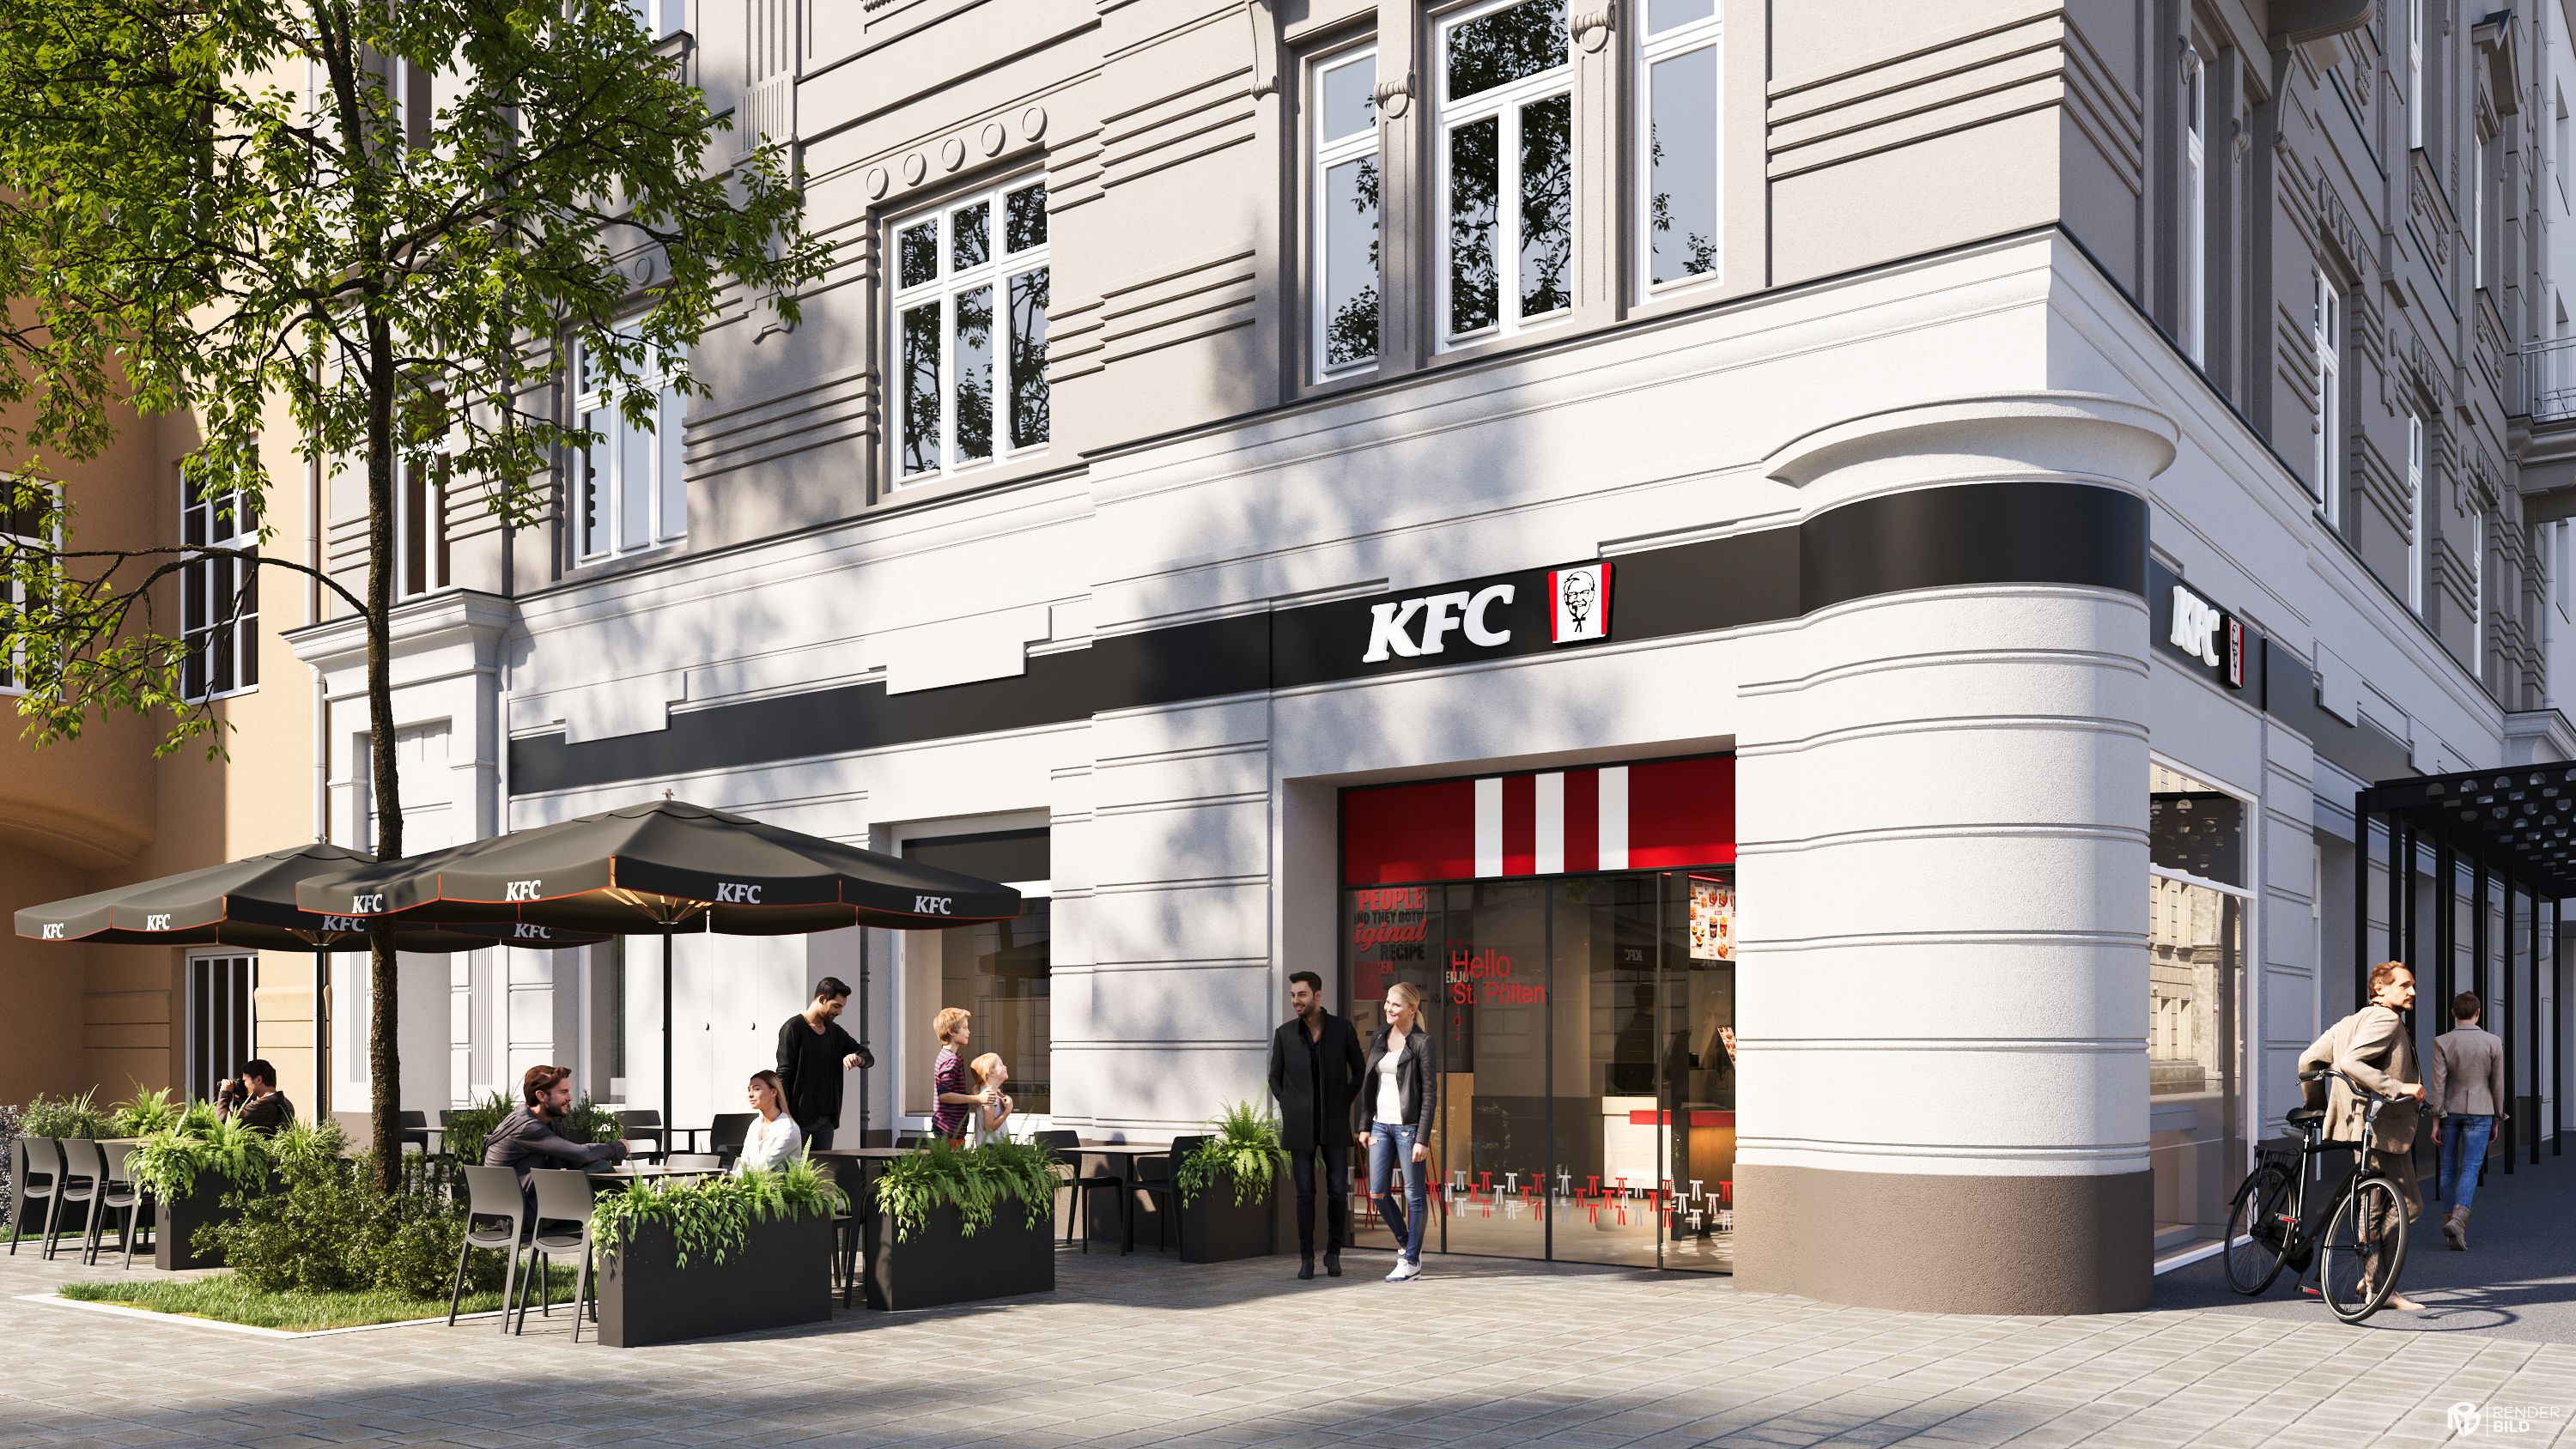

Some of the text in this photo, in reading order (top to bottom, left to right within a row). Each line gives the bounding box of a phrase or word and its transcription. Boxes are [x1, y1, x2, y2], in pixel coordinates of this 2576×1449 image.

[1362, 584, 1516, 664] KFC
[2170, 585, 2221, 667] KFC
[505, 880, 542, 902] KFC
[715, 882, 762, 904] KFC
[352, 894, 383, 914] KFC
[913, 895, 952, 915] KFC
[146, 913, 171, 931] KFC
[322, 915, 366, 932] KFC
[1354, 912, 1370, 925] ND
[1372, 912, 1396, 924] THEY
[42, 923, 64, 939] KFC
[513, 923, 551, 939] KFC
[1381, 943, 1425, 961] RECIPE
[1452, 949, 1511, 979] Hello
[1453, 982, 1478, 1004] St.
[1485, 981, 1546, 1003] Pölten
